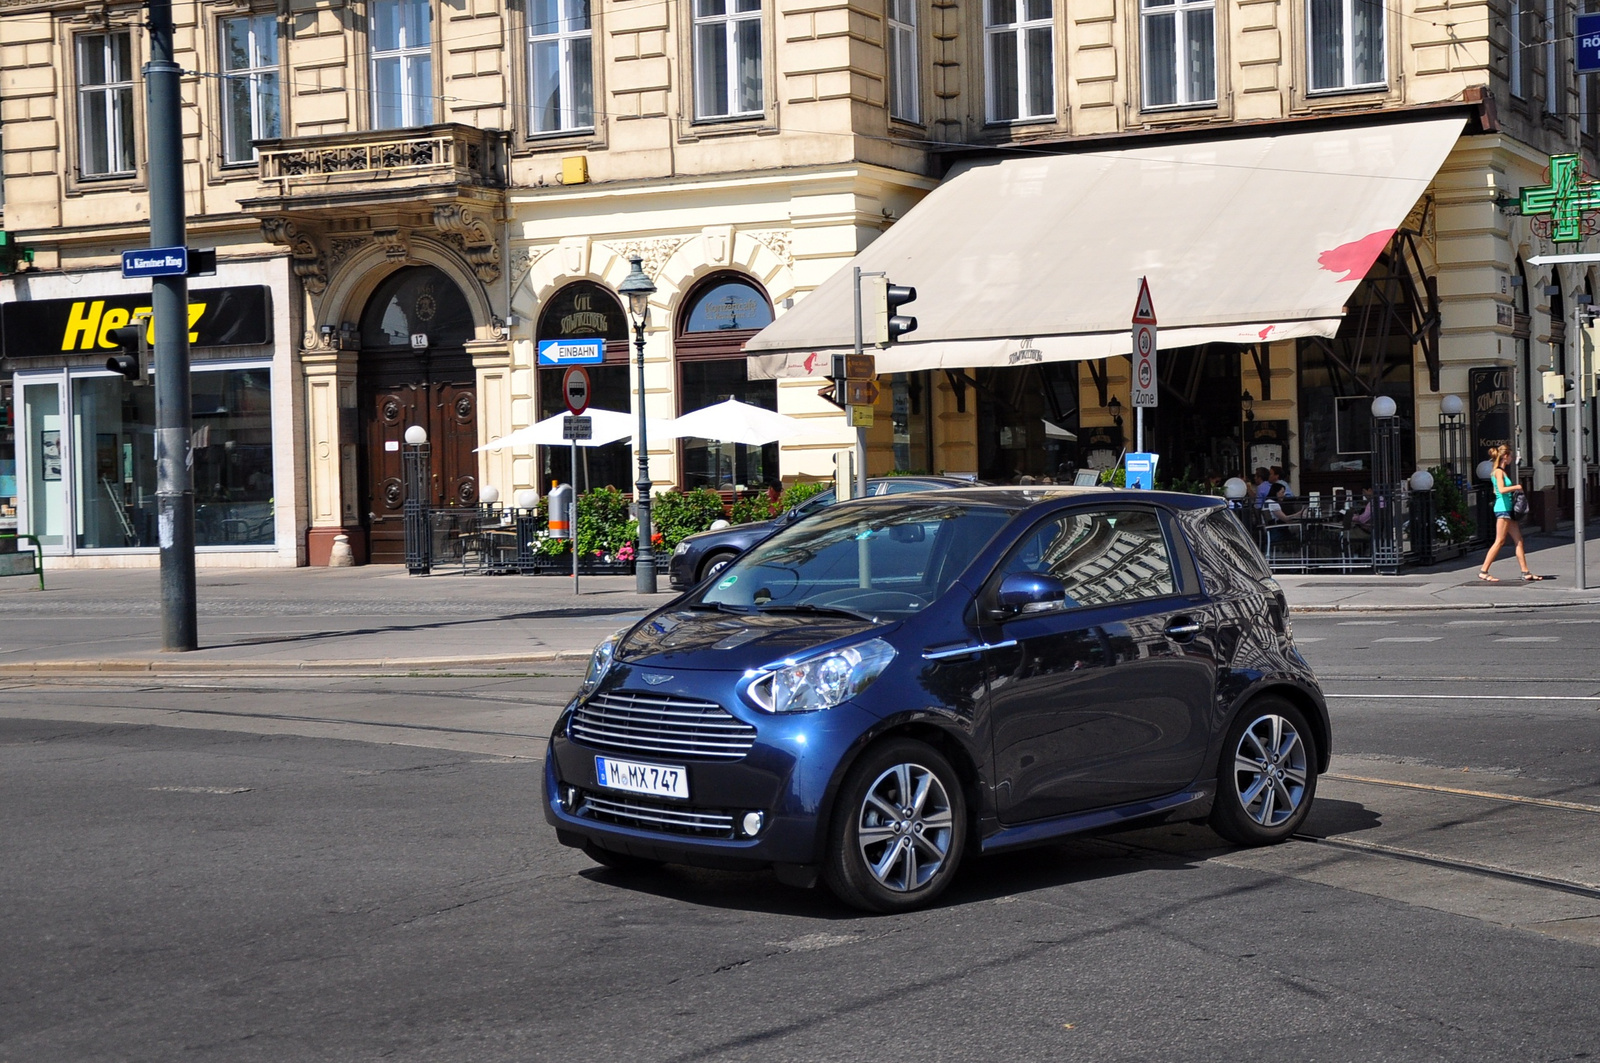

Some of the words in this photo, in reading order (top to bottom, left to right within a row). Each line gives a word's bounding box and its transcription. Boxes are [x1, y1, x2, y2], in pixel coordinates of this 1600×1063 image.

[165, 256, 182, 268] Ring
[61, 300, 206, 350] Hez
[415, 335, 423, 345] 17
[1142, 336, 1149, 349] 30
[559, 346, 595, 358] EINBAHN
[1135, 389, 1155, 404] Zone
[610, 762, 621, 784] M
